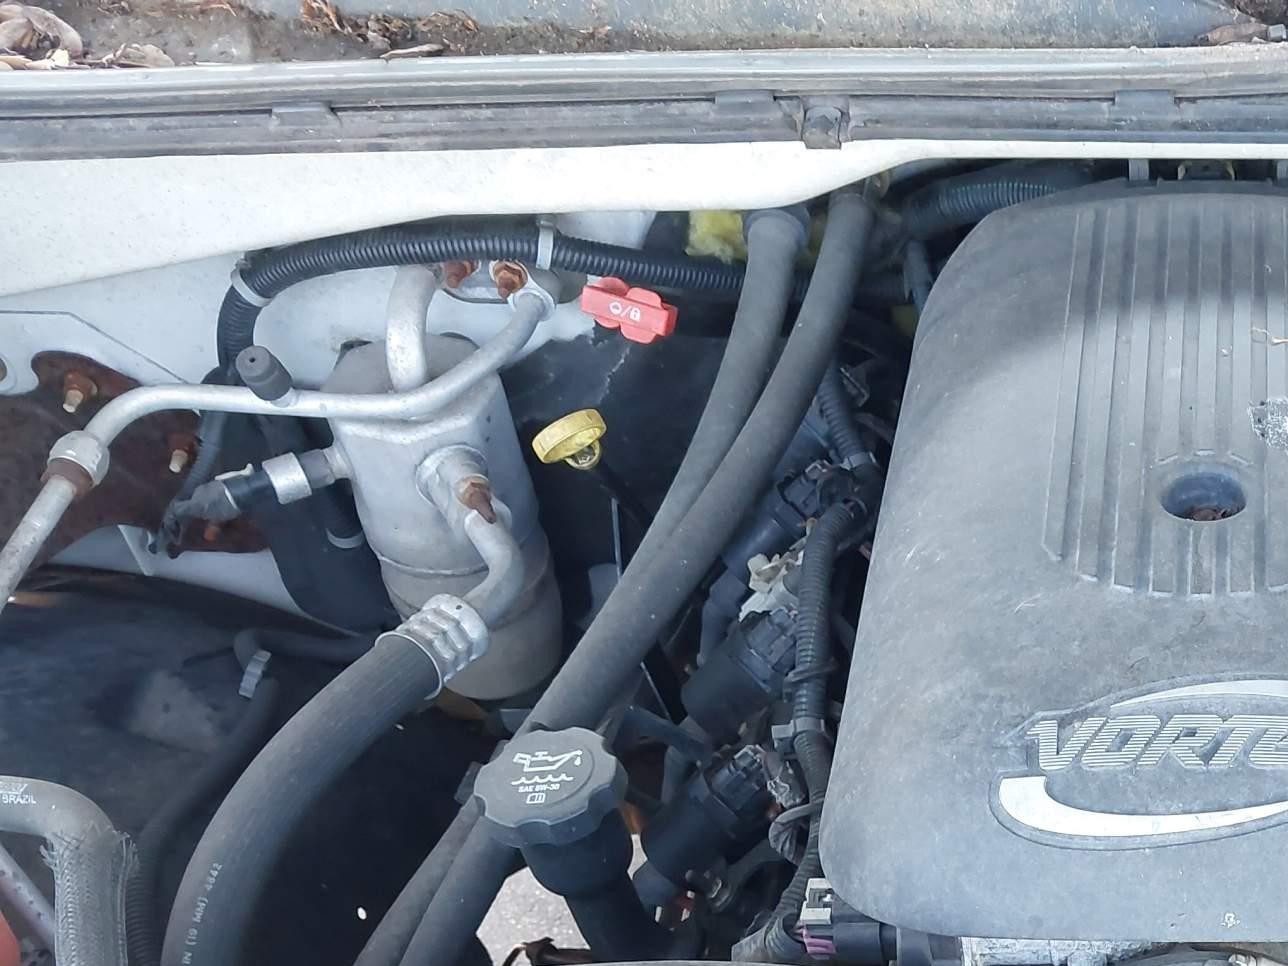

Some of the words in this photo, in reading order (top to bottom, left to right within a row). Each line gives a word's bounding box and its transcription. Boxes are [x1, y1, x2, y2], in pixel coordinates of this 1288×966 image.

[2, 793, 37, 805] BRAZIL
[182, 951, 193, 965] IN
[191, 896, 209, 923] MM)
